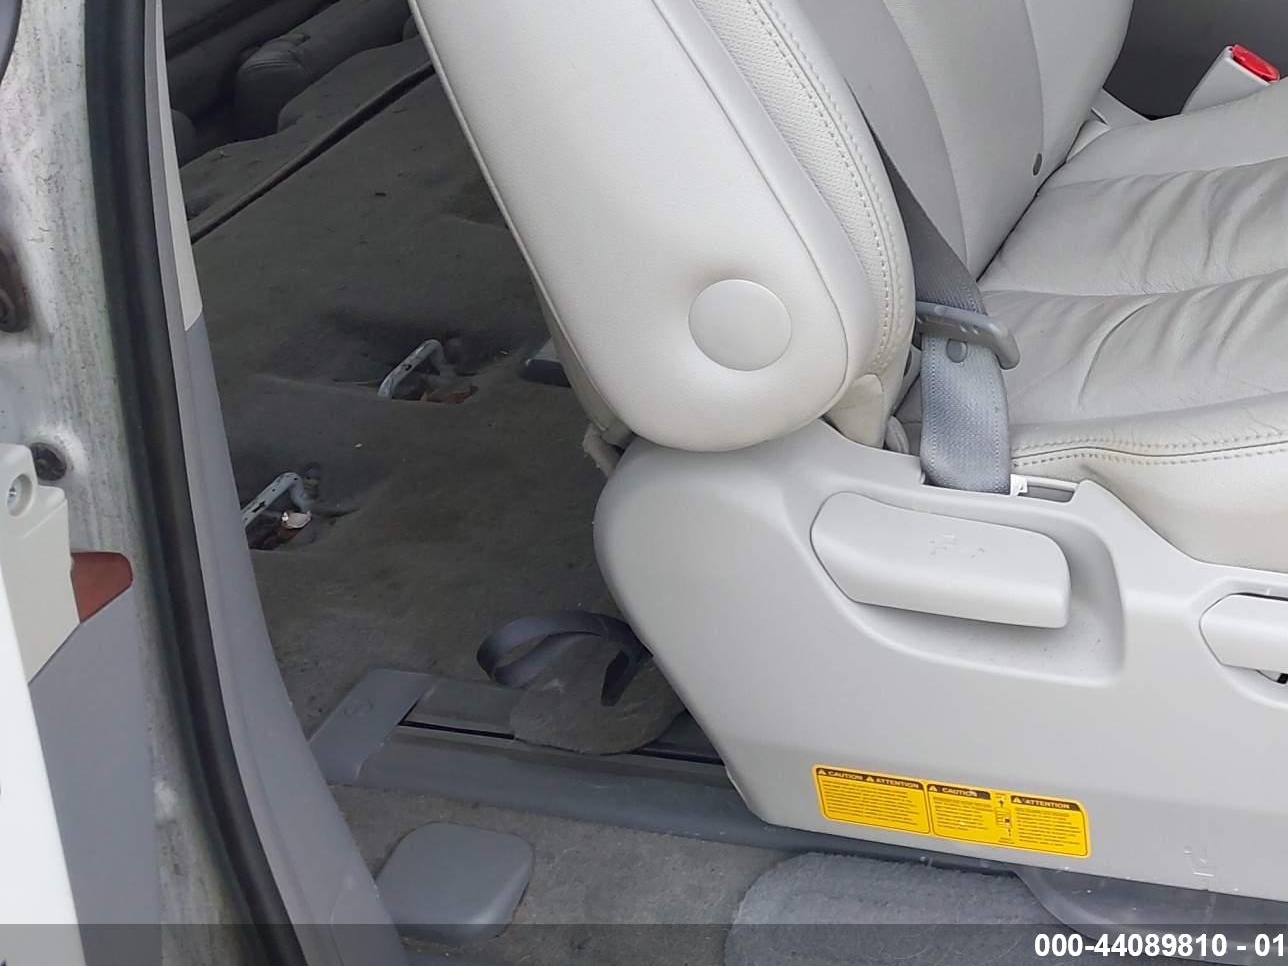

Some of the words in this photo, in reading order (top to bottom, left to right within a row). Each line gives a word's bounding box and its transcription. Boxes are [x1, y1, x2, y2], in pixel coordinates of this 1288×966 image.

[827, 770, 864, 781] CAUTION
[876, 777, 920, 789] ATTENTION
[941, 786, 978, 797] CAUTION
[1024, 798, 1071, 810] ATTENTION
